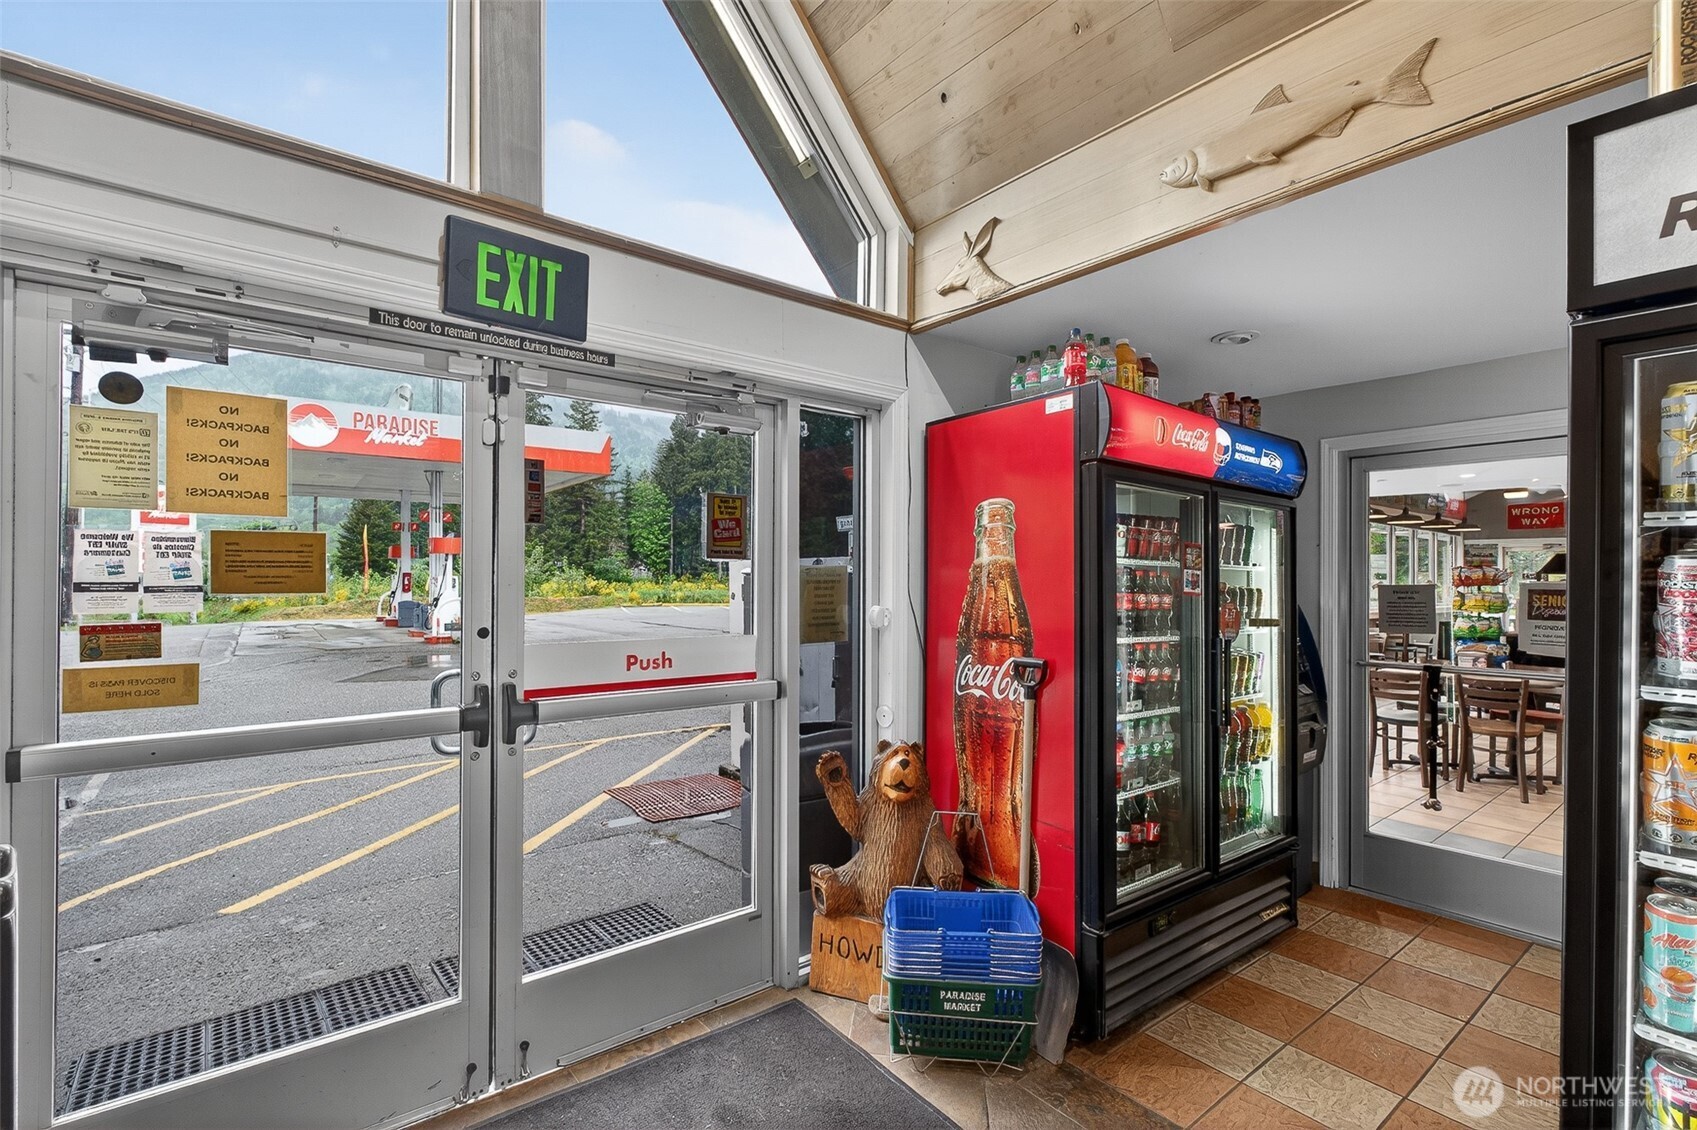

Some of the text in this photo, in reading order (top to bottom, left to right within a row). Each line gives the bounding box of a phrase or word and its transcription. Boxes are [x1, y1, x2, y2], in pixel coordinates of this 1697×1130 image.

[476, 241, 563, 322] EXIT
[378, 311, 609, 365] This door to remain unlocked during business hours
[353, 412, 439, 437] PARADISE
[364, 428, 427, 447] Market
[1511, 506, 1560, 516] WRONG
[1521, 517, 1550, 526] WAY
[625, 651, 673, 672] Push
[819, 932, 883, 968] HOWD
[940, 990, 986, 1002] PARADISE
[943, 1001, 982, 1012] MARKET
